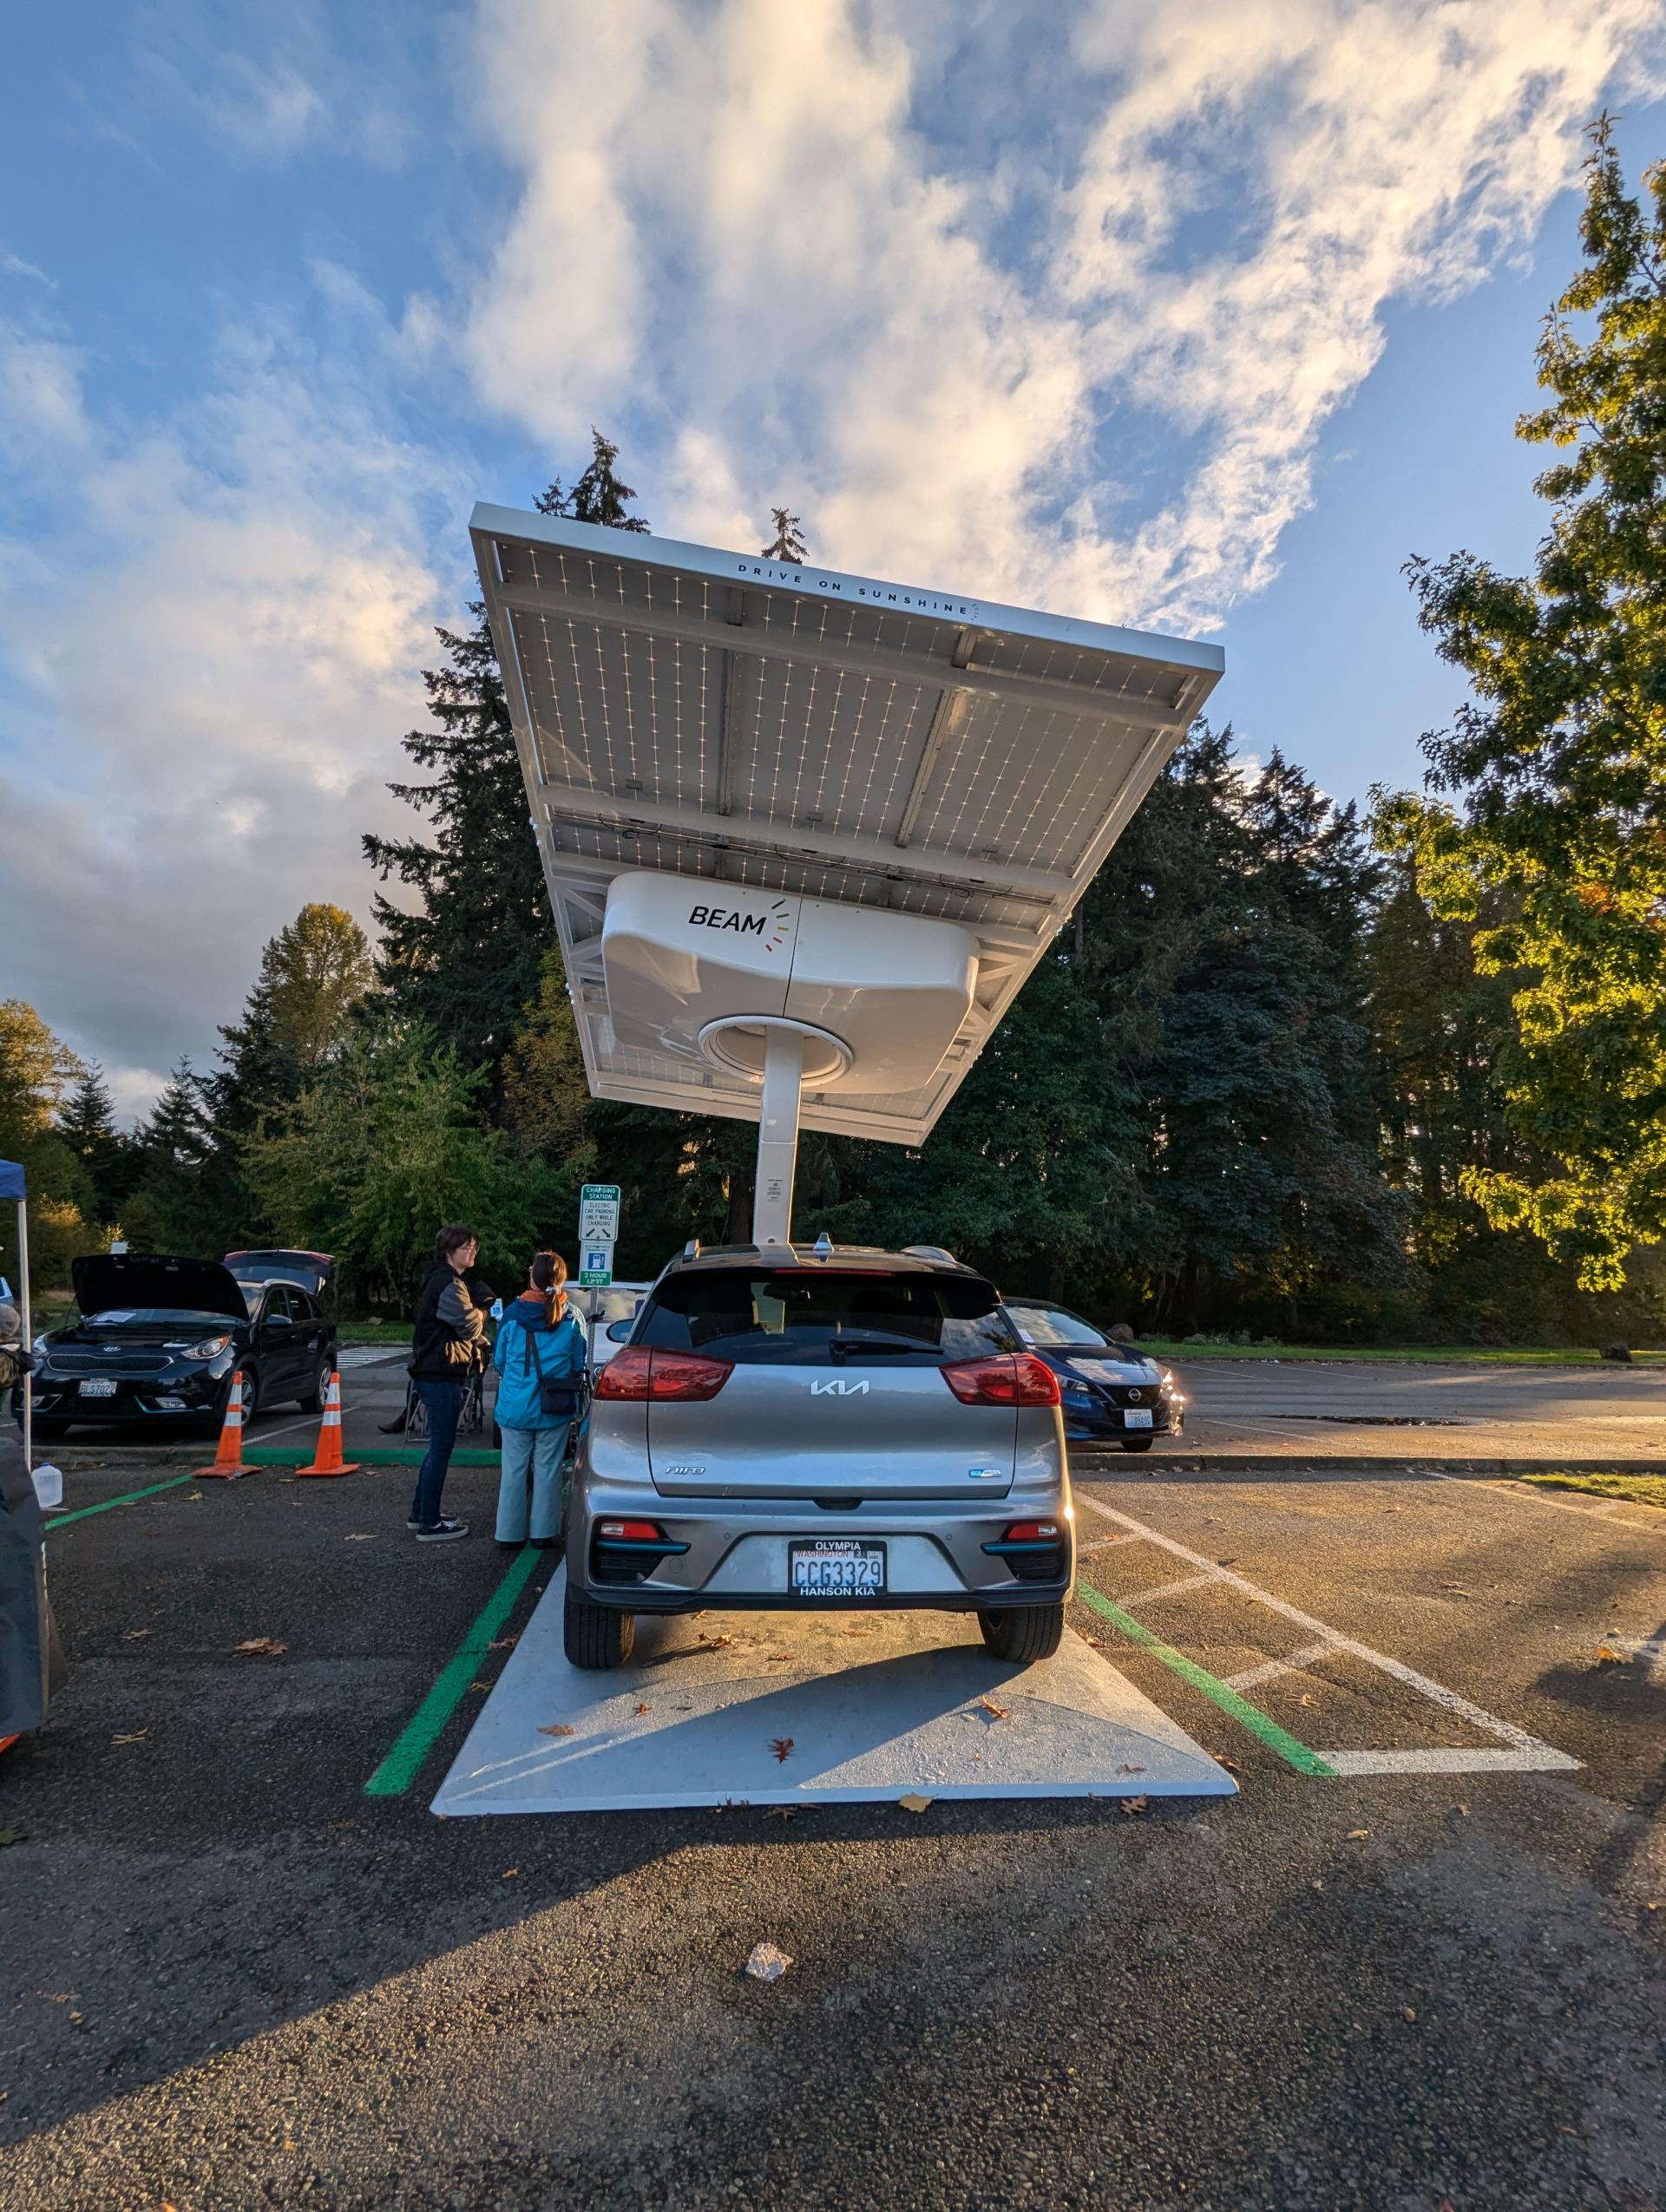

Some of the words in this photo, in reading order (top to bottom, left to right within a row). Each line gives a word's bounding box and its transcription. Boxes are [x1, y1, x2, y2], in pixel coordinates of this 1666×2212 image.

[738, 564, 803, 583] DRIVE
[819, 580, 841, 591] ON
[858, 587, 967, 615] SUNSHINE
[688, 905, 767, 935] BEAM
[810, 1380, 869, 1395] KIA
[815, 1541, 861, 1550] OLYMPIA
[795, 1561, 881, 1586] CCG3329
[800, 1587, 852, 1596] HANSON
[856, 1587, 876, 1596] KIA
